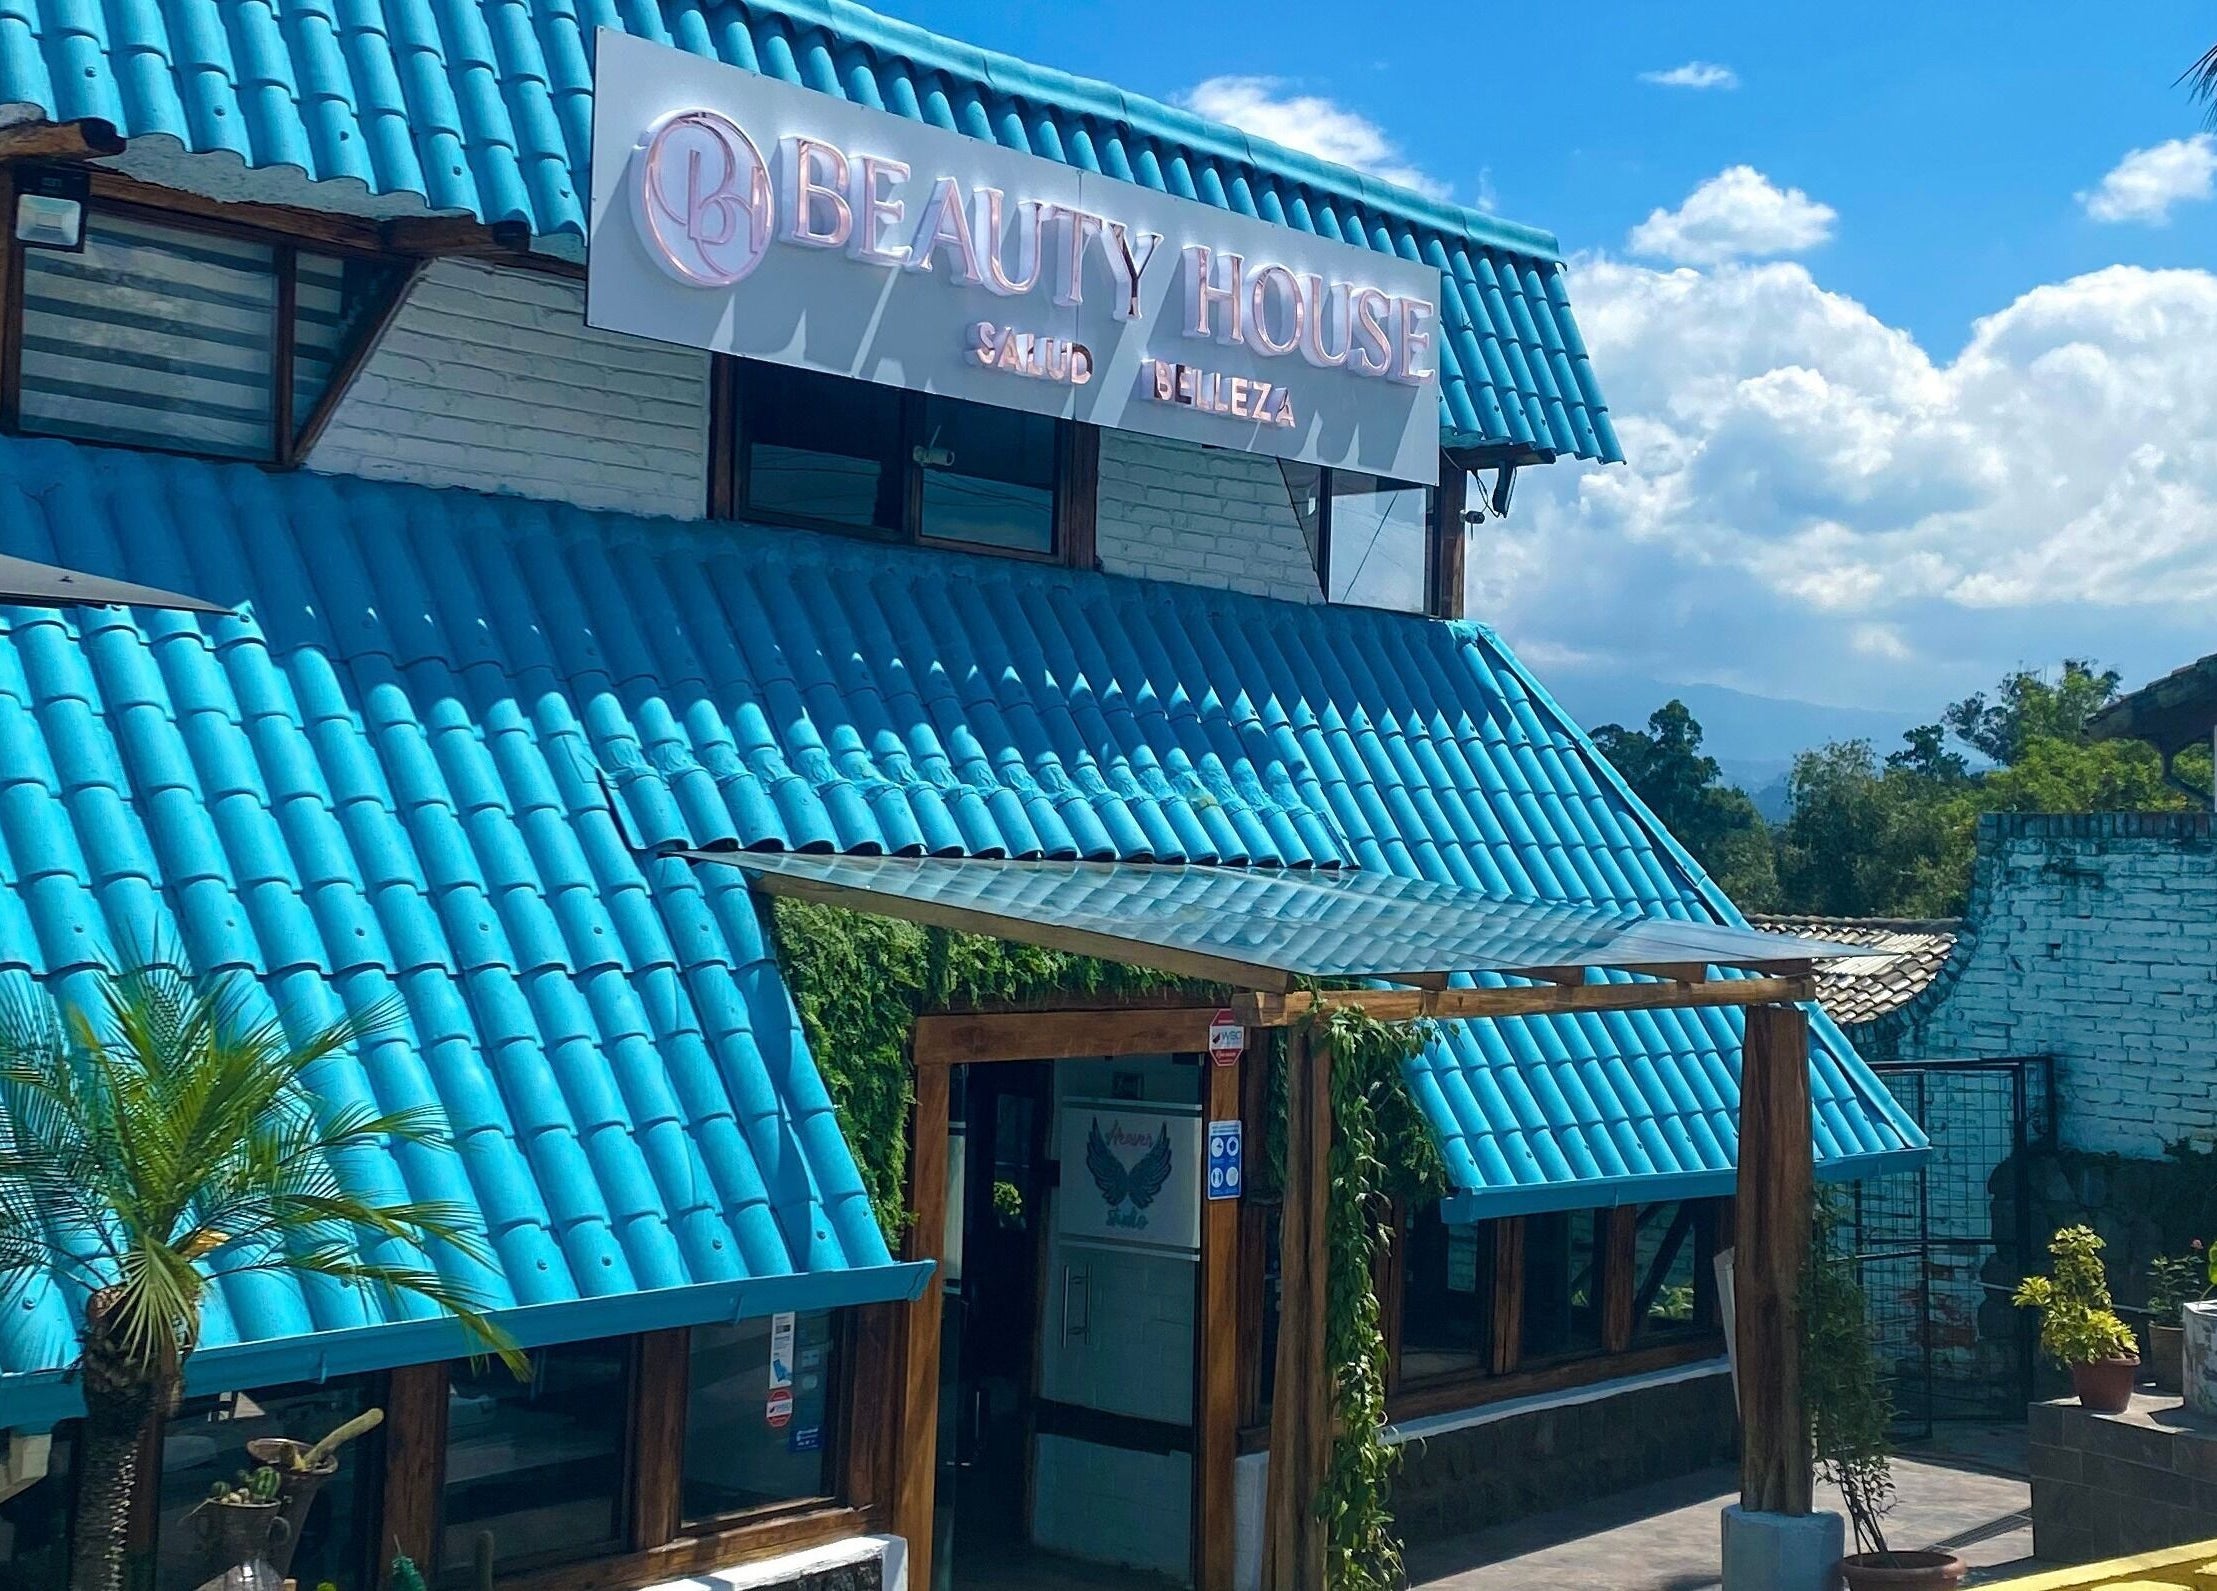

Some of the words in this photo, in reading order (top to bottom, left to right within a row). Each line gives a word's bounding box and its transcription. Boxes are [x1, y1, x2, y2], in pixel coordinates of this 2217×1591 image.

[780, 136, 1164, 320] BEAUTY
[1182, 245, 1434, 385] HOUSE
[967, 321, 1094, 385] SALUD
[1141, 359, 1297, 428] BELLEZA
